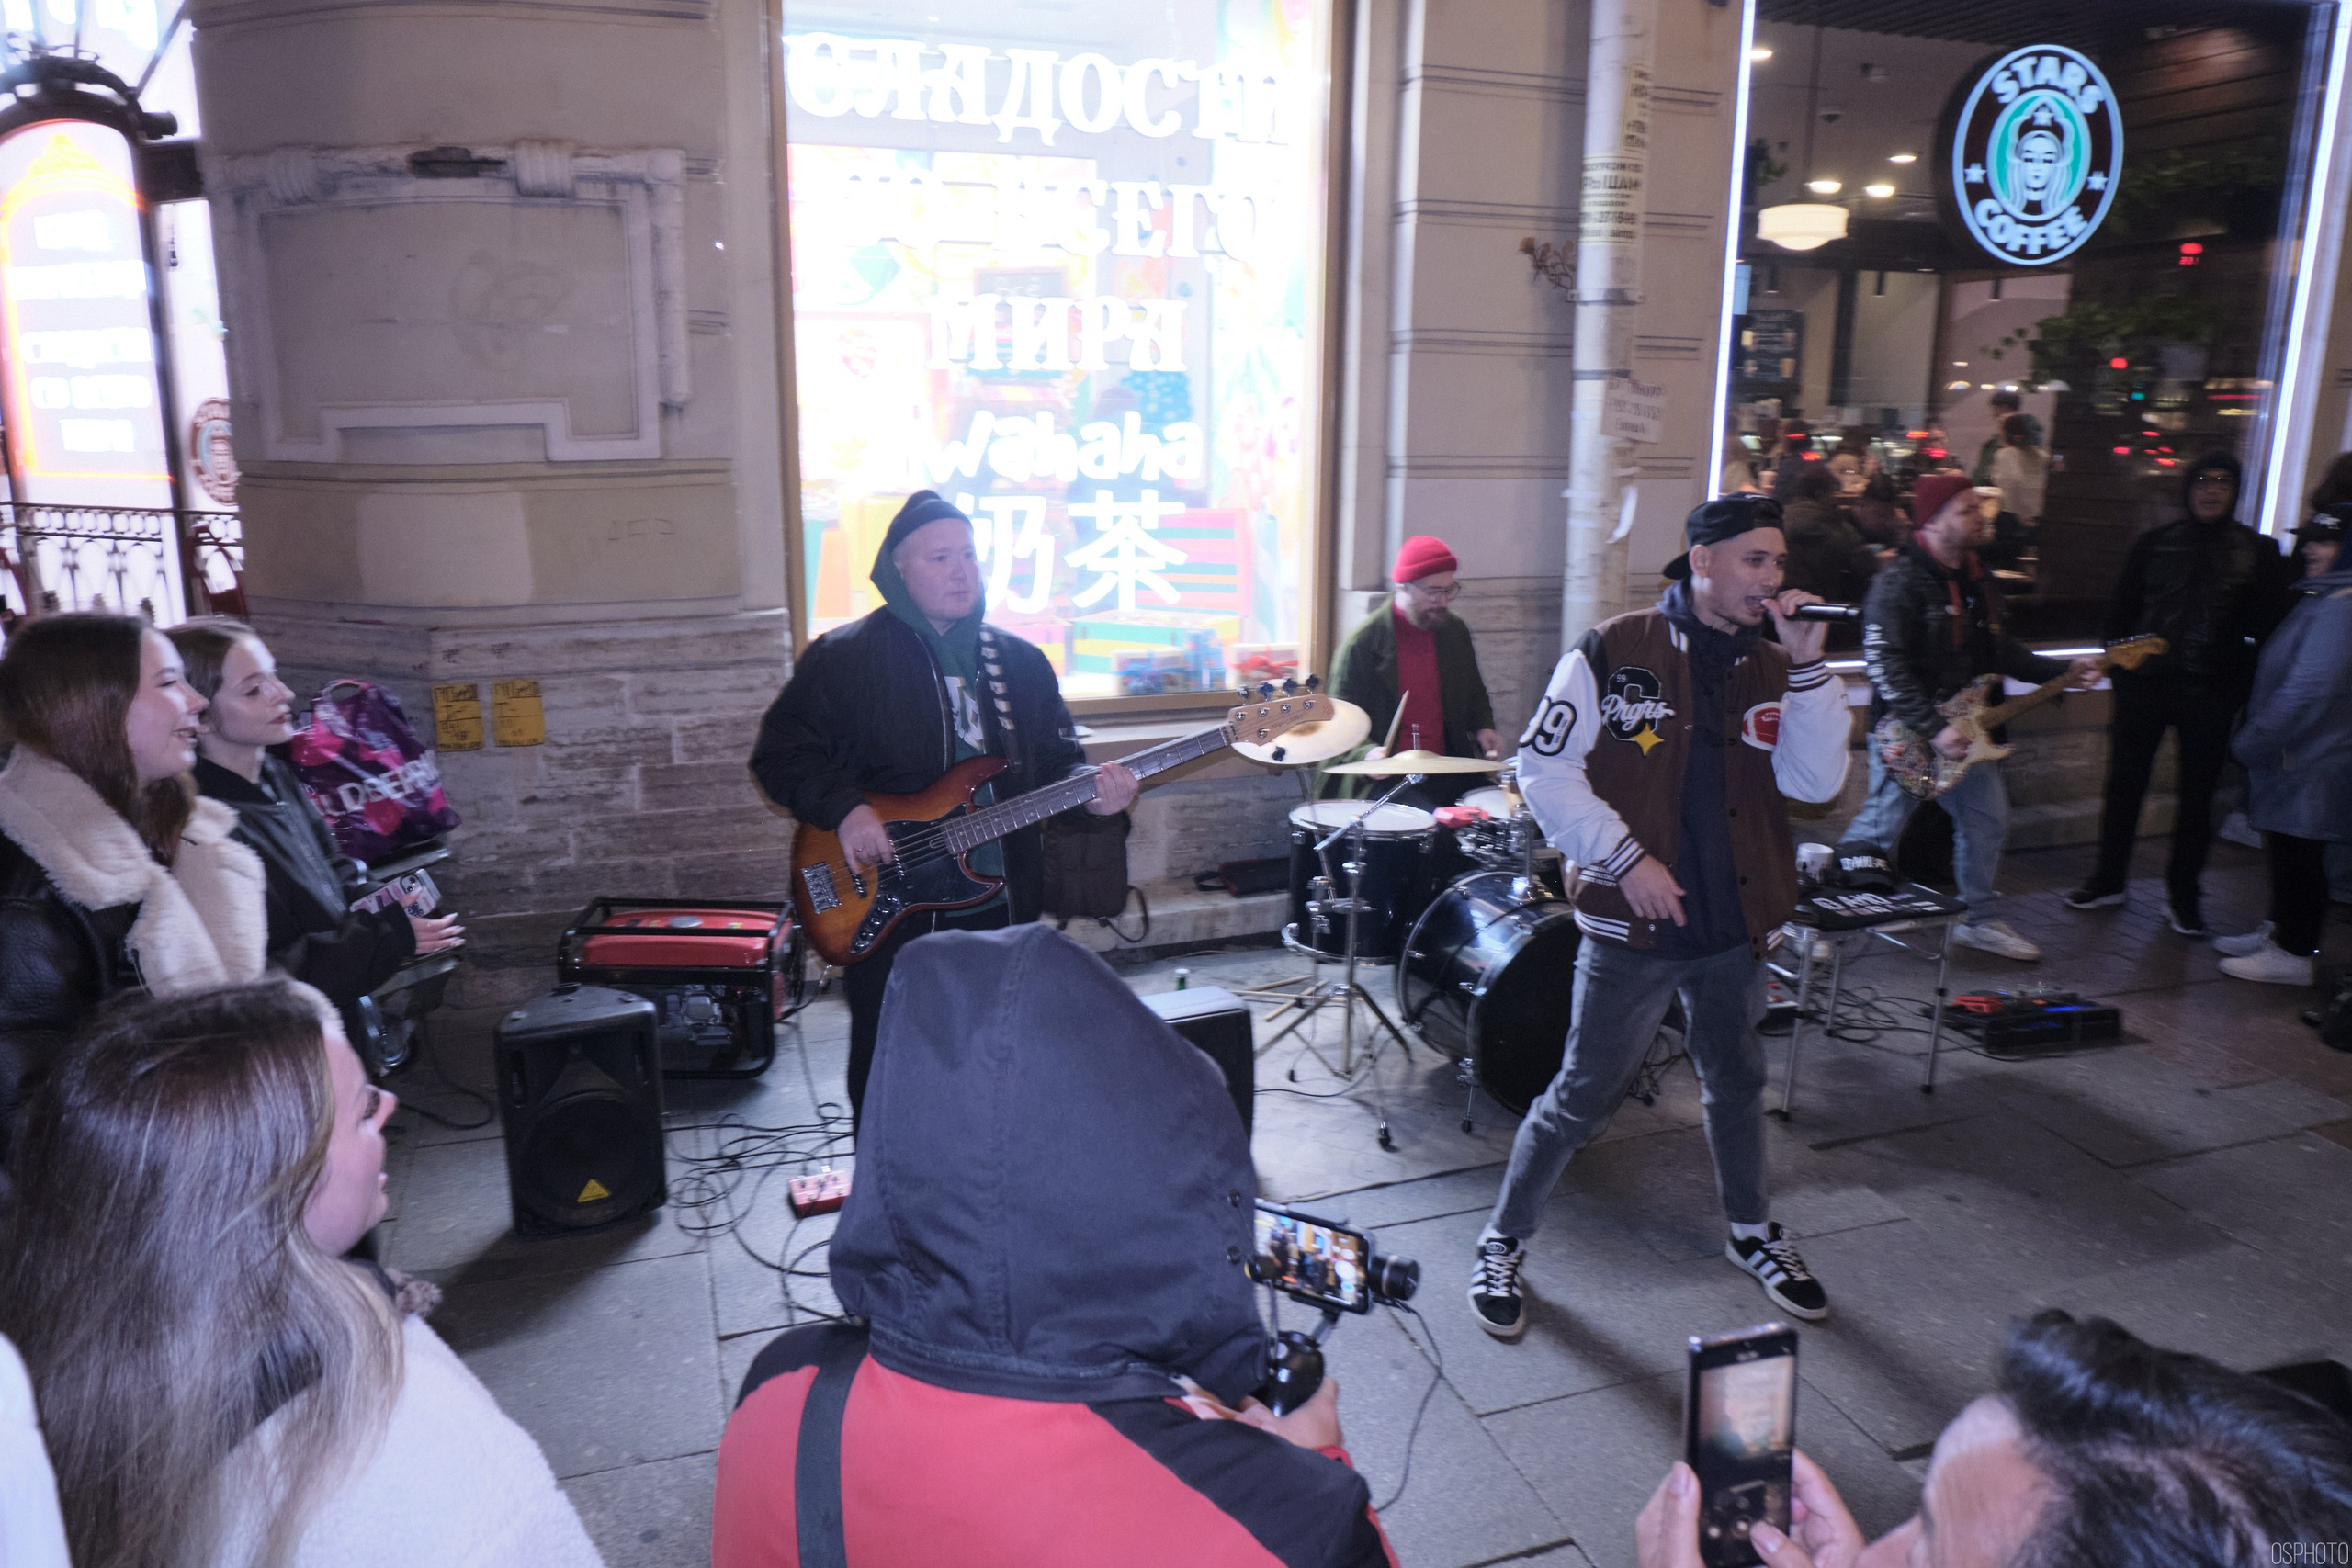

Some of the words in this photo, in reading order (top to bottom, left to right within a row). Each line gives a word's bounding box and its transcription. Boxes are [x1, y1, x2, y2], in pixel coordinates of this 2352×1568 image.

[783, 32, 1294, 145] СЛАДОСТИ
[1990, 56, 2107, 114] STARS
[1974, 198, 2088, 255] COFFEE
[926, 294, 1187, 371] МИРА
[952, 489, 1189, 615] 奶茶
